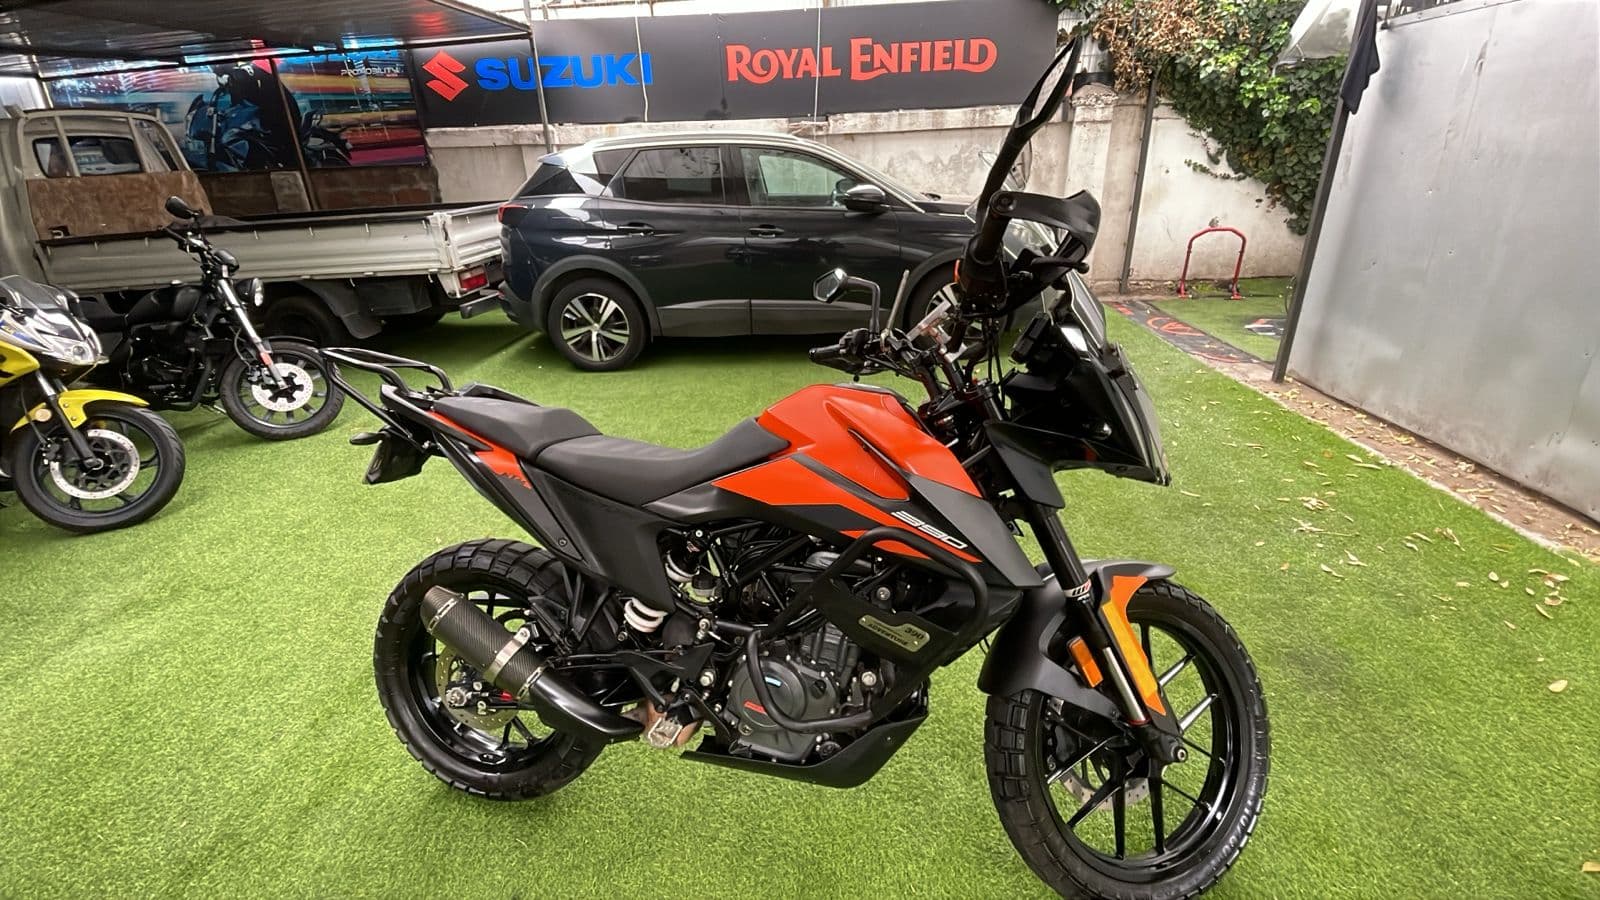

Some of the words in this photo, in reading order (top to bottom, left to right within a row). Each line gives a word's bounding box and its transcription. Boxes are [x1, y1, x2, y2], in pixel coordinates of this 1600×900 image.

[474, 52, 653, 91] SUZUKI
[724, 44, 842, 84] ROYAL
[849, 37, 998, 81] ENFIELD
[890, 510, 968, 549] 390
[905, 627, 925, 640] 390
